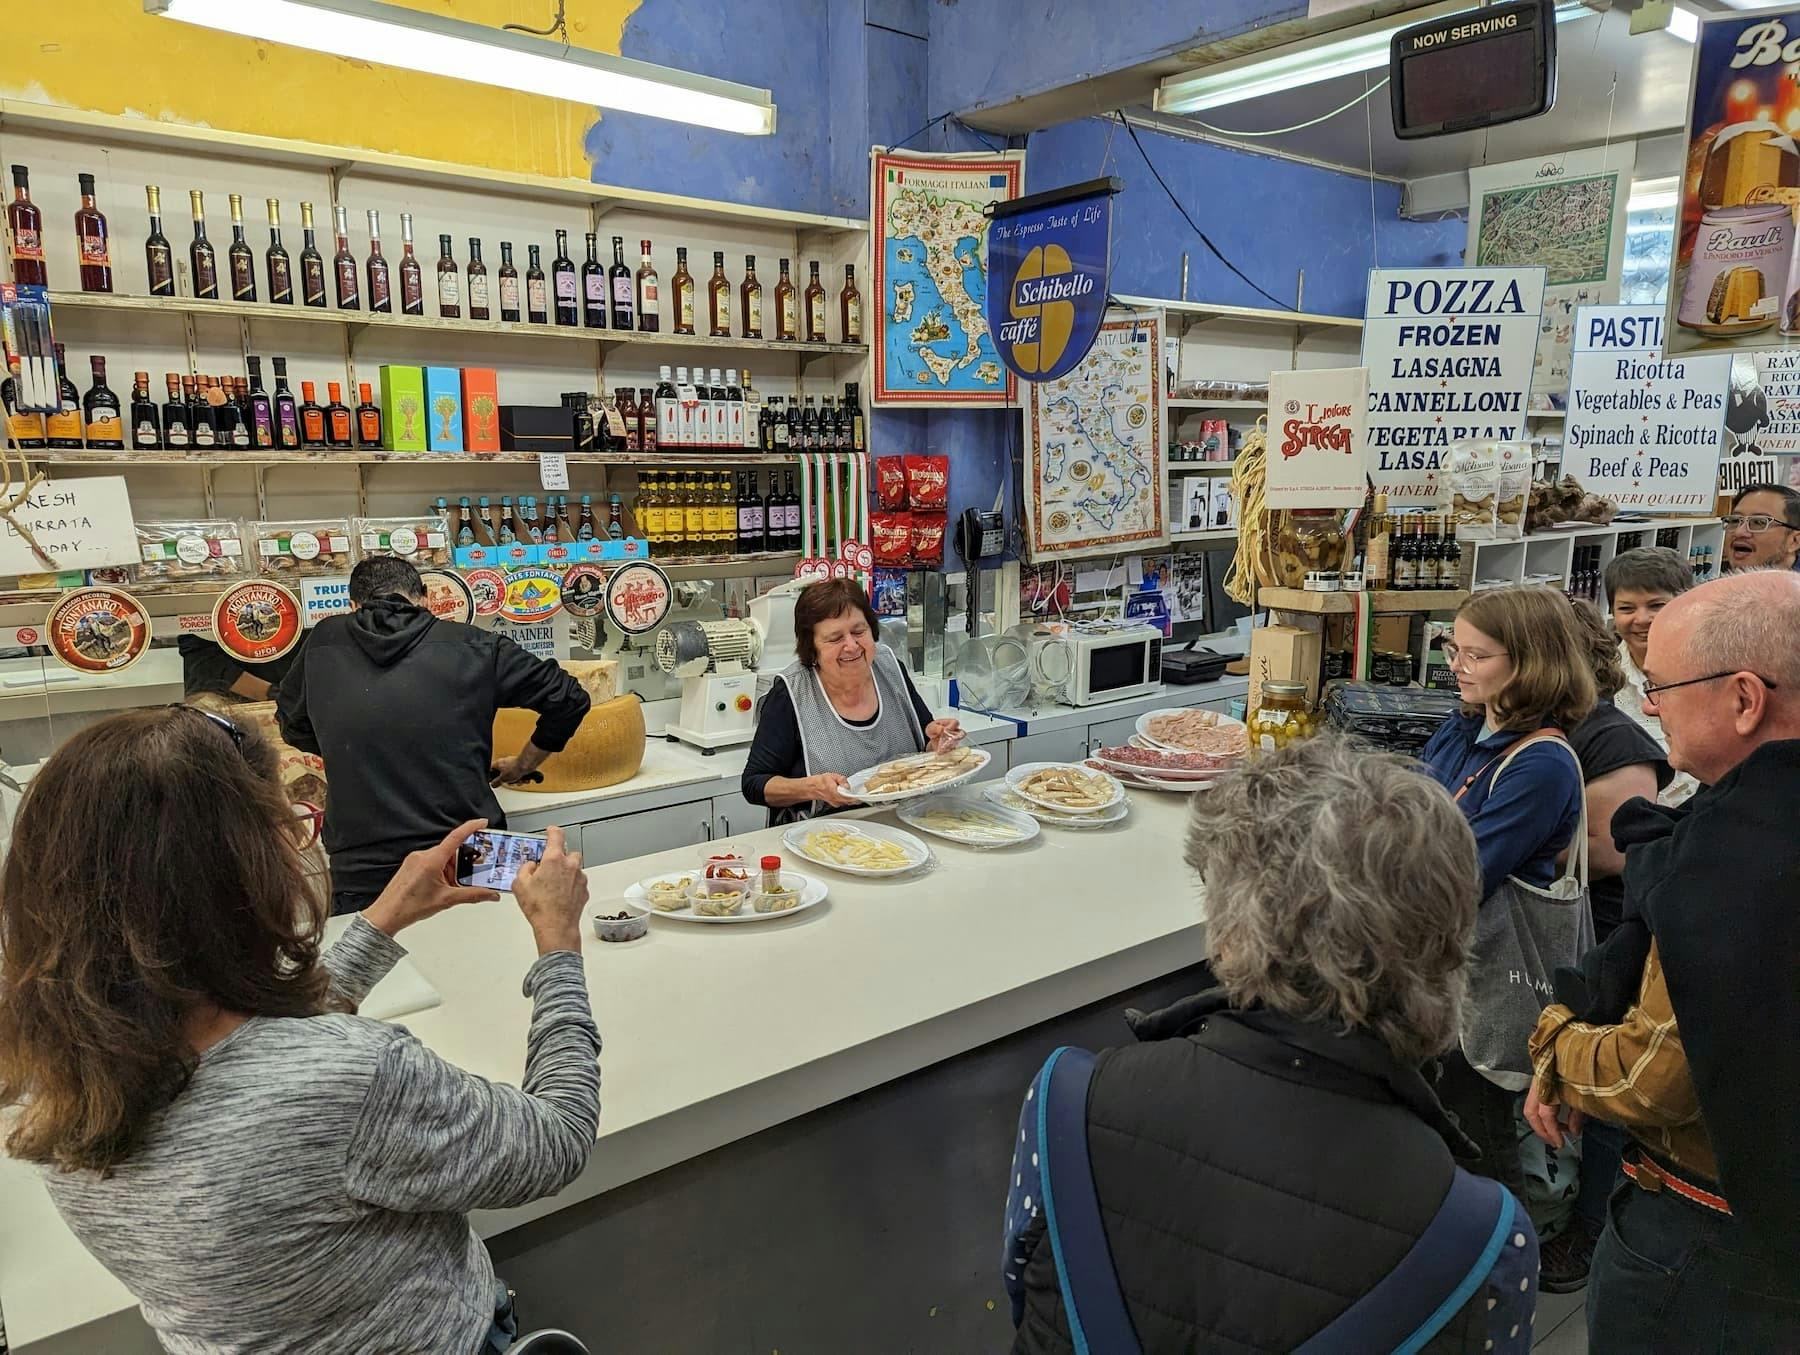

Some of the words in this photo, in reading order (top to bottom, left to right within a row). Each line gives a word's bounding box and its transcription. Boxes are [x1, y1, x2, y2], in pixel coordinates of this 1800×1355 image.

[1413, 30, 1448, 50] NOW
[1451, 14, 1518, 40] SERVING
[904, 178, 948, 189] FORMAGGI
[951, 180, 988, 190] ITALIANI
[996, 227, 1011, 240] The
[1014, 223, 1044, 239] Espresso
[1047, 215, 1068, 230] Taste
[1071, 209, 1081, 228] of
[1083, 204, 1102, 224] Life
[1706, 226, 1783, 251] Bauli
[1019, 272, 1093, 304] Schibello
[1384, 279, 1525, 315] POZZA
[1398, 324, 1501, 346] FROZEN
[1589, 316, 1664, 348] PASTI
[1391, 357, 1502, 378] LASAGNA
[1615, 359, 1685, 380] Ricotta
[1368, 392, 1522, 412] CANNELLONI
[1575, 388, 1661, 414] Vegetables
[1666, 392, 1678, 410] &
[1682, 389, 1722, 410] Peas
[1281, 419, 1352, 461] STREGA
[1569, 424, 1634, 449] Spinach
[1639, 428, 1650, 445] &
[1655, 424, 1717, 445] Ricotta
[1588, 457, 1629, 478] Beef
[1632, 461, 1643, 478] &
[1648, 457, 1689, 478] Peas
[1381, 484, 1439, 497] RAINERI
[1647, 494, 1706, 506] QUALITY
[525, 569, 559, 583] FONTANA
[81, 593, 111, 601] PECORINO
[229, 590, 281, 613] MONTANARO
[62, 600, 118, 631] MONTANARO
[511, 627, 553, 641] RAINERI
[254, 646, 278, 657] SIFOR
